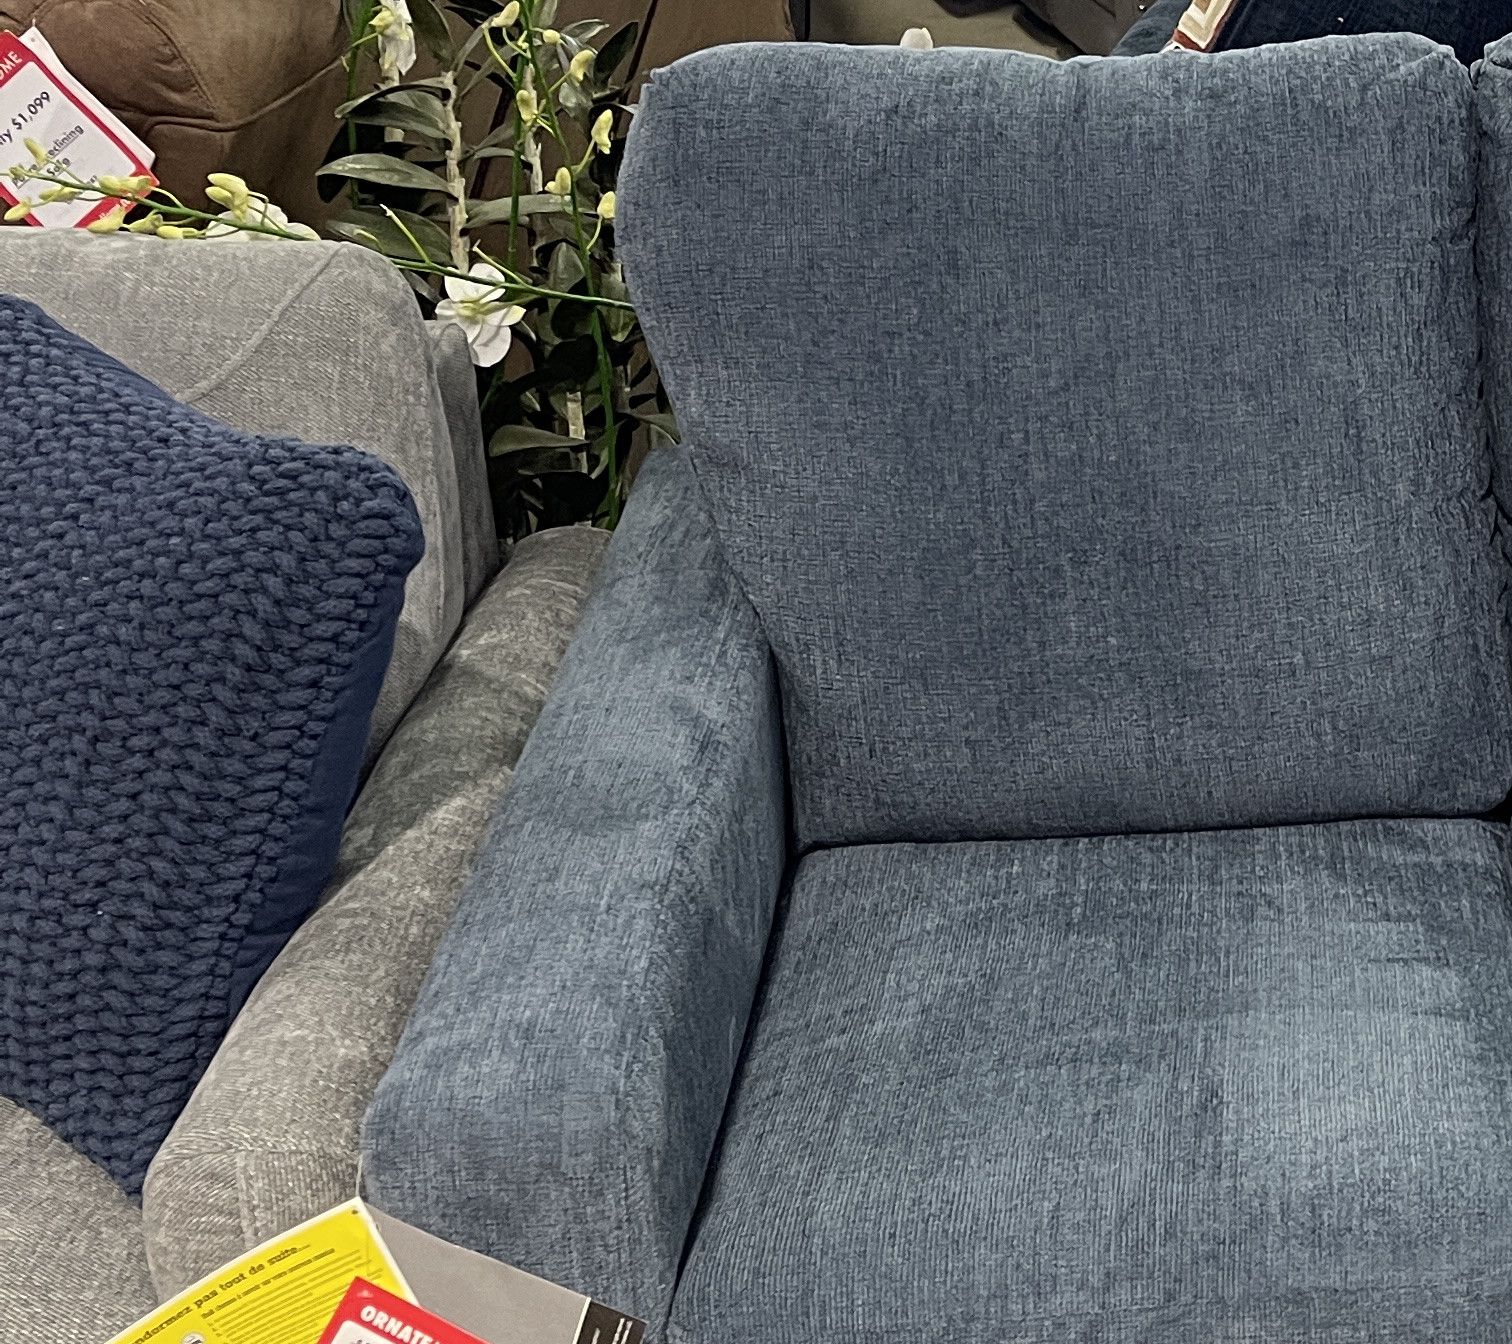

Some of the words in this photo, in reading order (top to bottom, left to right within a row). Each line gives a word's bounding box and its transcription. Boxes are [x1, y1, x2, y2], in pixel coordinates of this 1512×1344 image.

[11, 91, 51, 131] $1,099
[47, 124, 84, 156] eclining
[194, 1289, 219, 1310] pas
[218, 1272, 247, 1292] tout
[248, 1262, 266, 1276] de
